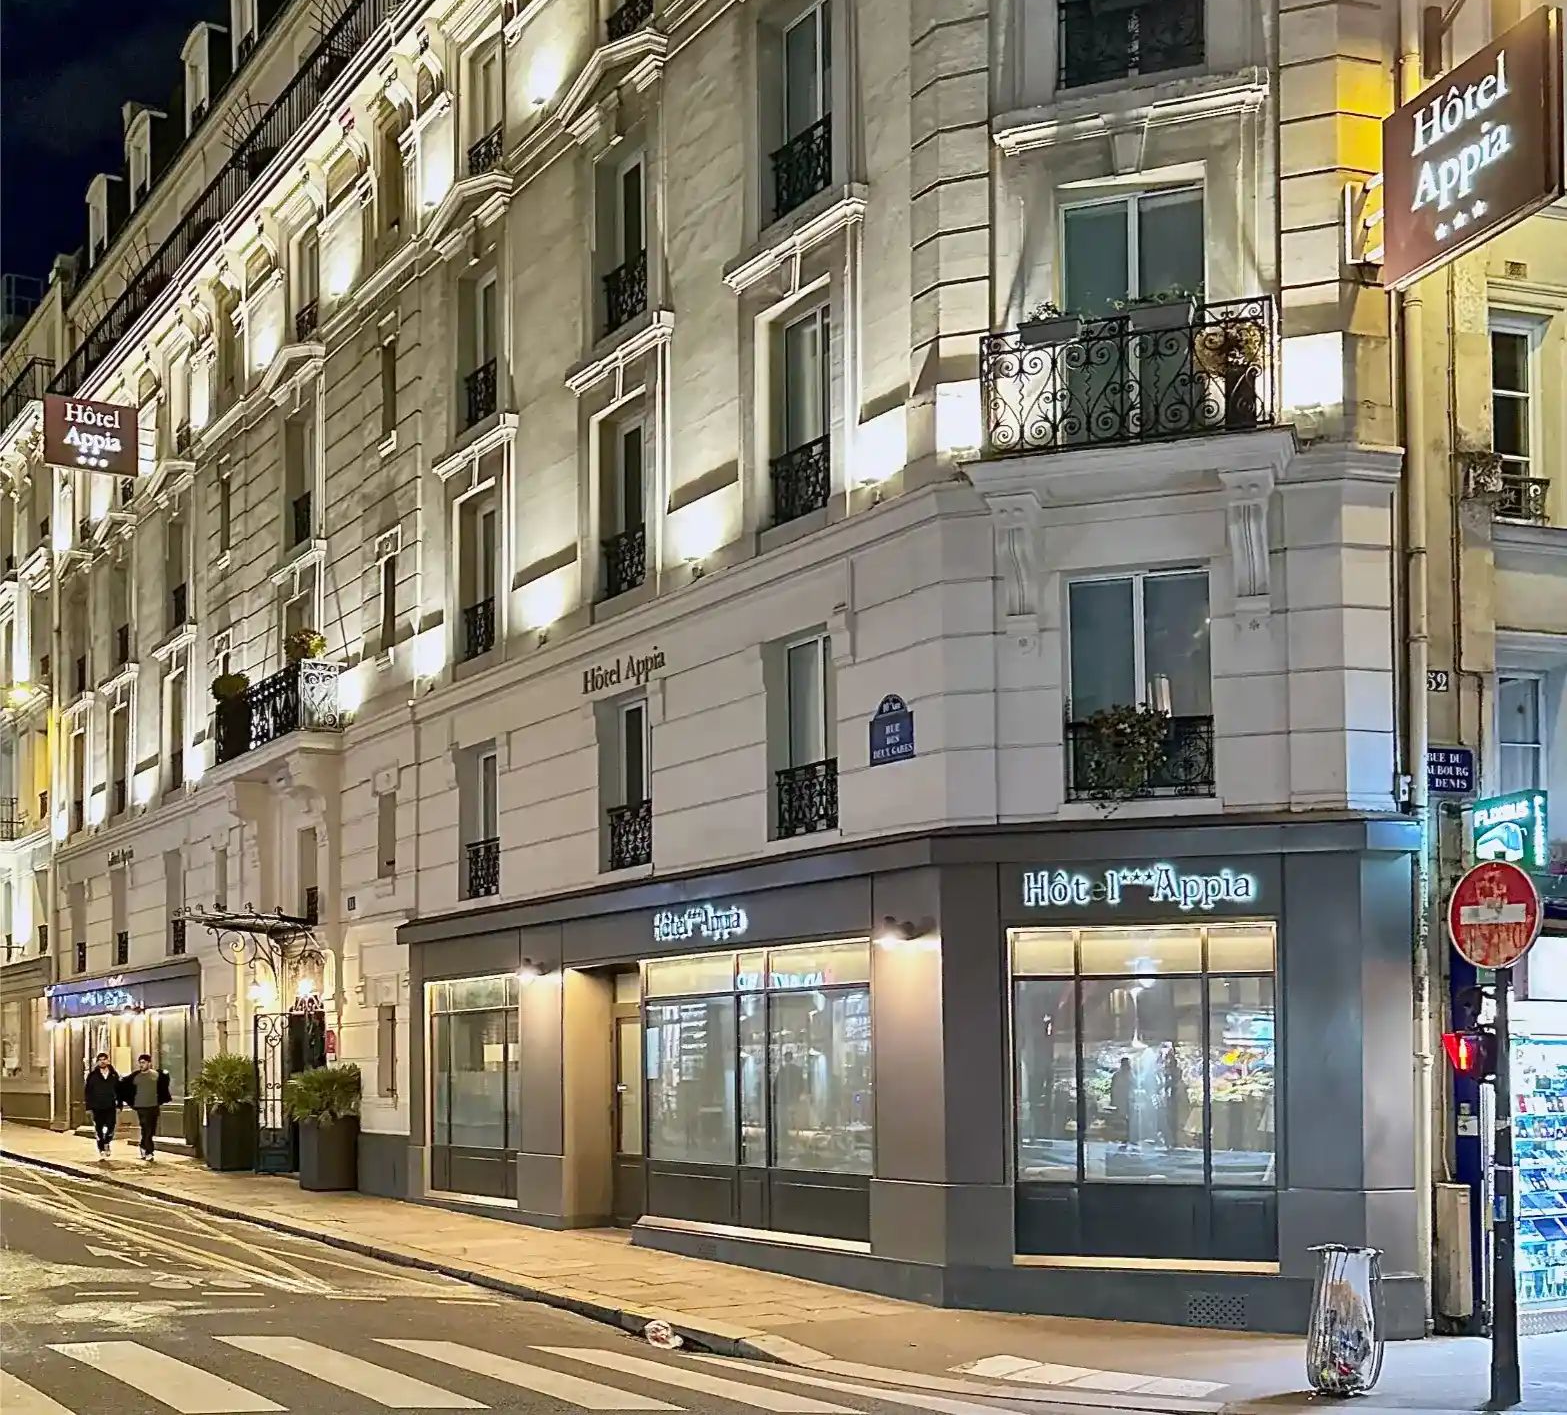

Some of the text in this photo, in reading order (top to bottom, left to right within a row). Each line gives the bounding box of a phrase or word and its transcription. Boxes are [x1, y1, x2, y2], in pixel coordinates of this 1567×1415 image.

[1411, 49, 1510, 157] Hôtel
[1410, 121, 1512, 213] Appia
[64, 402, 121, 429] Hôtel
[63, 425, 122, 455] Appia
[581, 645, 666, 695] Hôtel Appia
[885, 723, 901, 735] RUE
[1427, 752, 1463, 764] RUE DU
[1435, 778, 1468, 789] DENIS
[1023, 862, 1256, 911] Hôtel Appia
